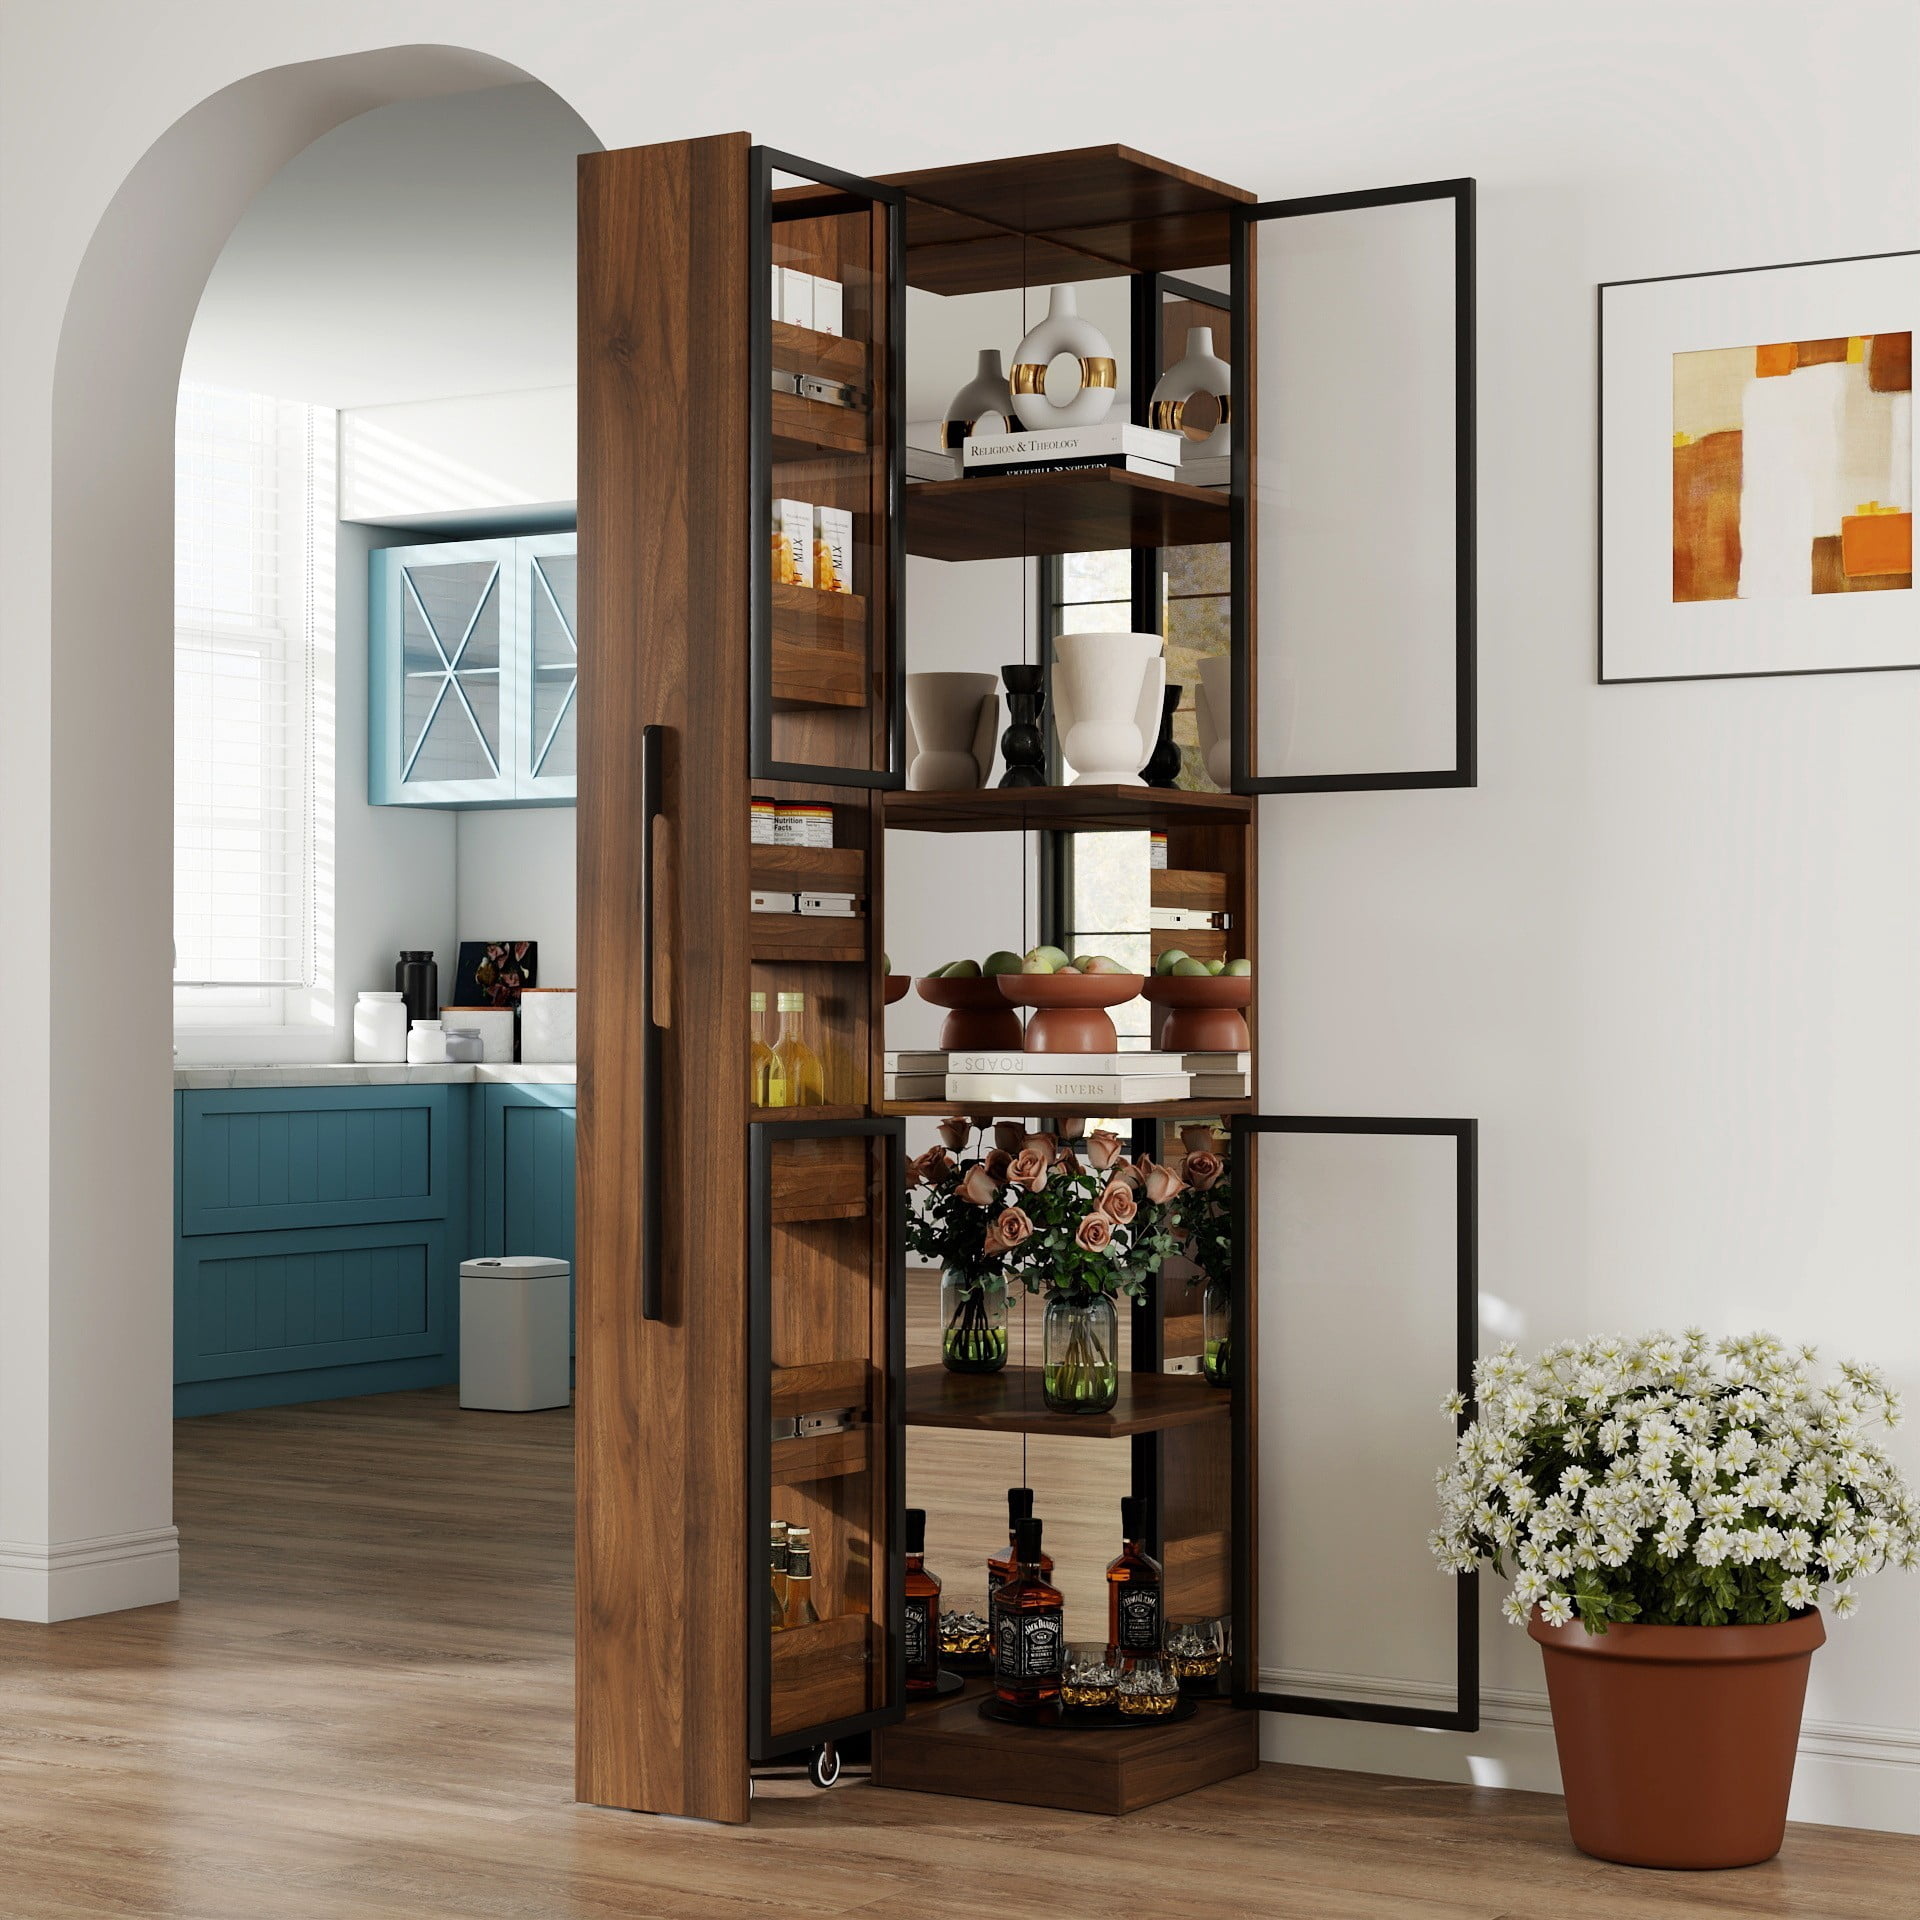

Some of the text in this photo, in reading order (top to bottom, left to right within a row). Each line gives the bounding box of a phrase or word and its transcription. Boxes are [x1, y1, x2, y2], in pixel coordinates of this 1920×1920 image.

[971, 439, 1079, 457] RELIGION & THEOLOGY
[793, 538, 803, 562] MIX
[832, 545, 843, 569] MIX
[774, 816, 803, 824] Nutrition
[965, 1057, 1024, 1071] ROADS
[1055, 1084, 1105, 1095] RIVERS
[1025, 1621, 1039, 1635] JACK
